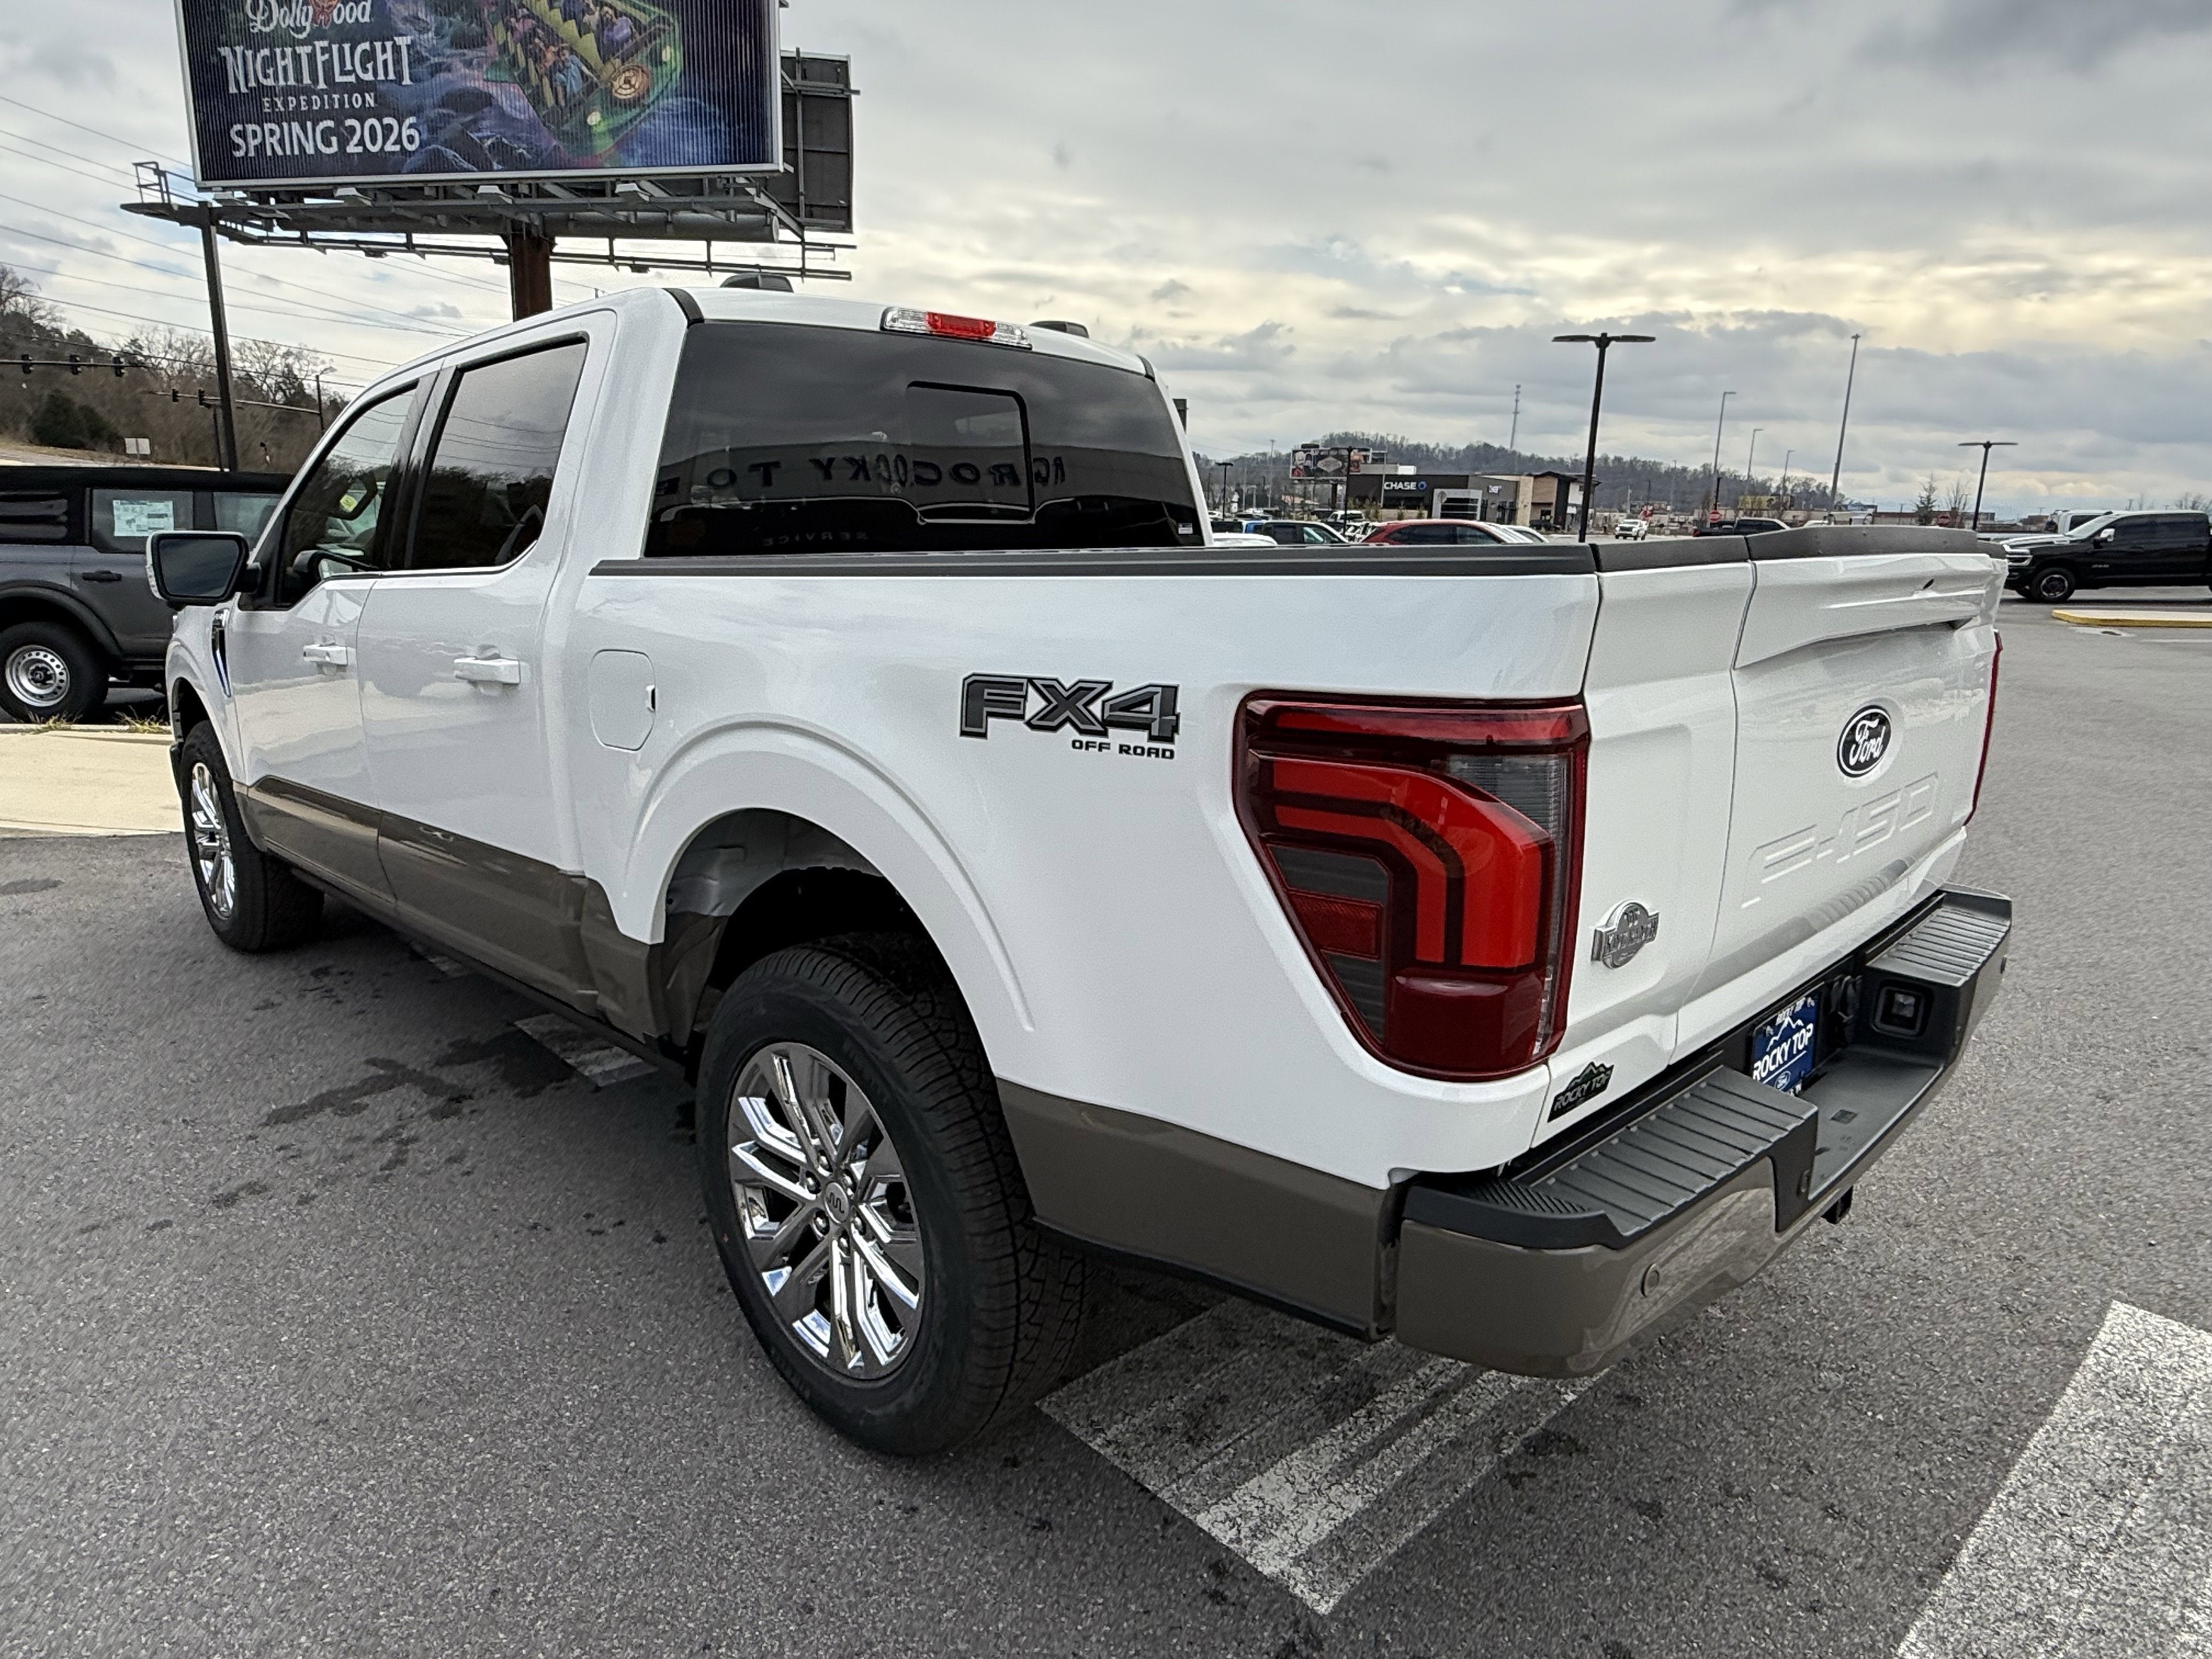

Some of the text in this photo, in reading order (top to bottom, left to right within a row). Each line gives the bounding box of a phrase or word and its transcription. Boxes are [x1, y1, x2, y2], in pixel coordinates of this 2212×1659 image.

[218, 35, 414, 93] NIGHTFLIGHT
[262, 92, 375, 112] EXPEDITION
[230, 116, 420, 157] SPRING 2026
[1384, 482, 1417, 490] CHASE
[960, 672, 1181, 744] FX4
[1071, 739, 1175, 760] OFF ROAD
[1849, 718, 1886, 766] Ford
[1741, 772, 1939, 909] F-150
[1753, 1038, 1791, 1081] ROCKY
[1792, 1023, 1814, 1054] TOP
[1553, 1080, 1591, 1111] ROCKY
